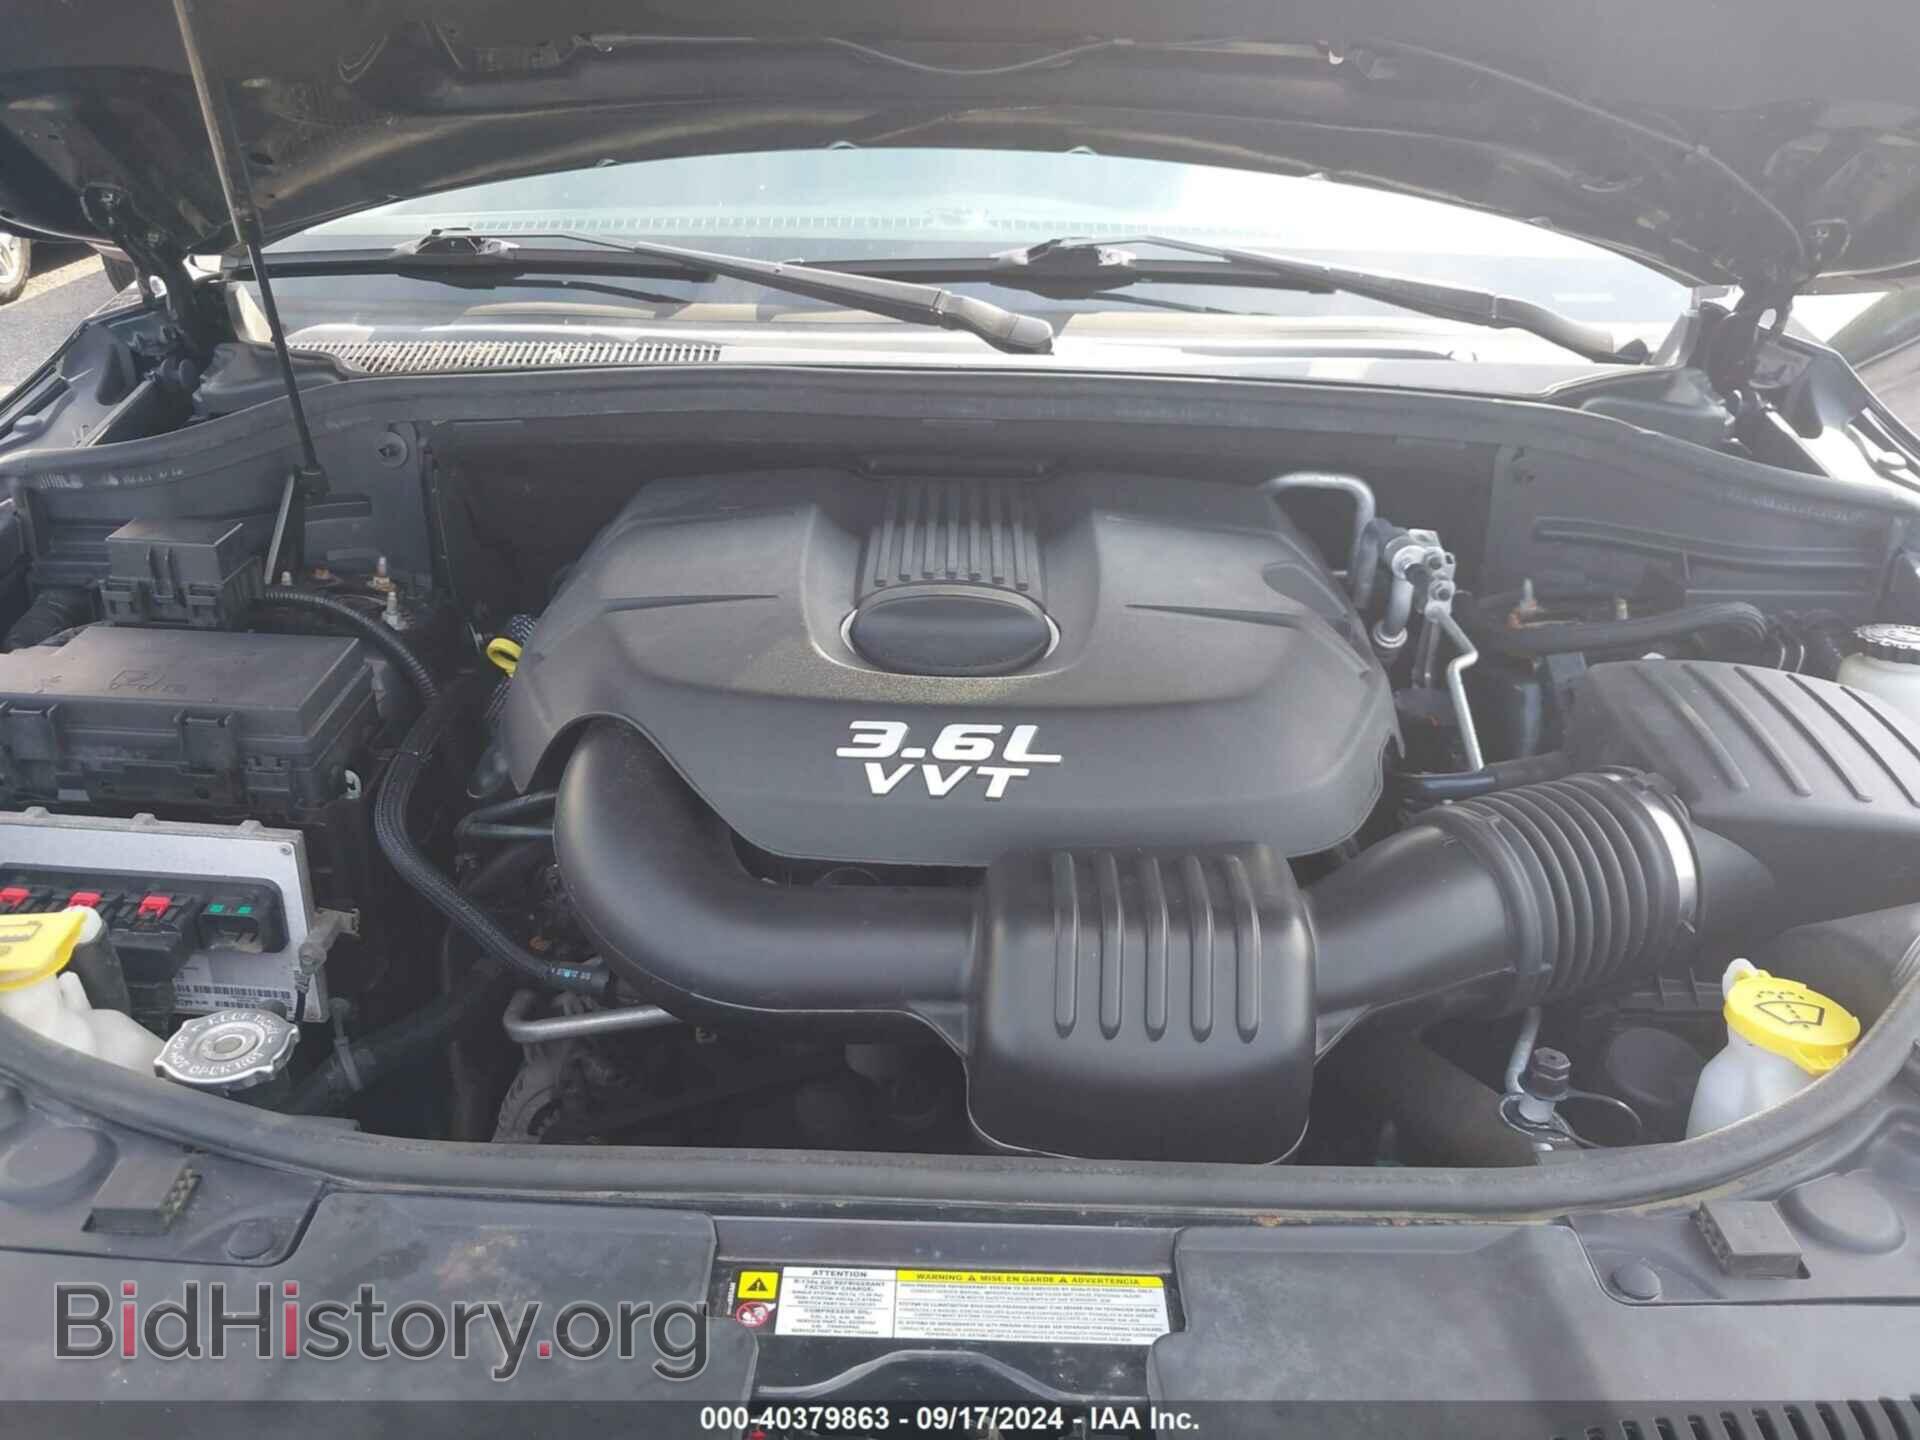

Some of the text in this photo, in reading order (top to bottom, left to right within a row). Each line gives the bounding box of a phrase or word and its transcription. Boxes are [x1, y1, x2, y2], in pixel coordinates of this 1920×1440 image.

[836, 720, 1062, 763] 3.6L
[864, 762, 1030, 798] VVT
[812, 1269, 868, 1278] ATTENTION
[916, 1273, 963, 1281] WARNING
[979, 1274, 1001, 1282] MISE
[1022, 1275, 1054, 1283] GARDE
[1071, 1277, 1140, 1285] ADVERTENCIA
